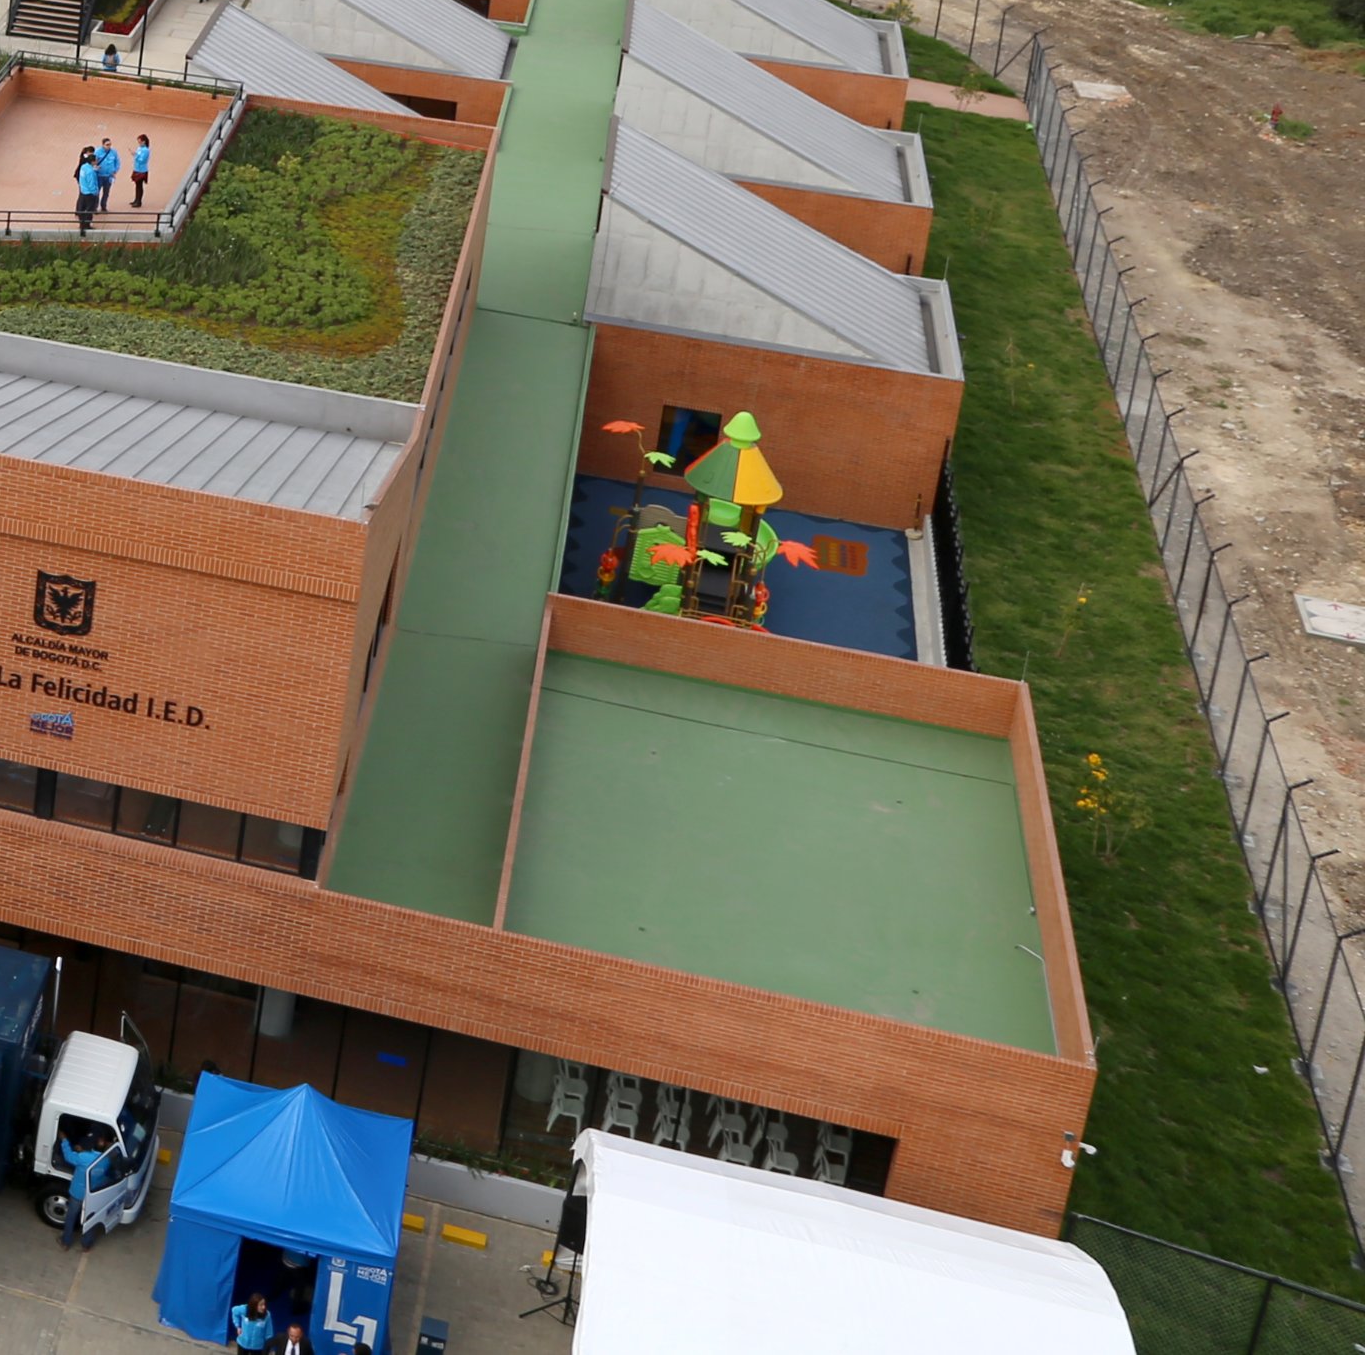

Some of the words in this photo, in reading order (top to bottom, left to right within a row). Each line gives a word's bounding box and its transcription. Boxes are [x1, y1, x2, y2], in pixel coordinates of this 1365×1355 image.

[11, 633, 66, 652] ALCALDÍA
[68, 643, 109, 661] MAYOR
[14, 646, 31, 657] DE
[32, 649, 79, 667] BOGOTÁ
[81, 659, 103, 672] D.C.
[30, 673, 139, 715] Felicidad
[147, 697, 211, 730] I.E.D.
